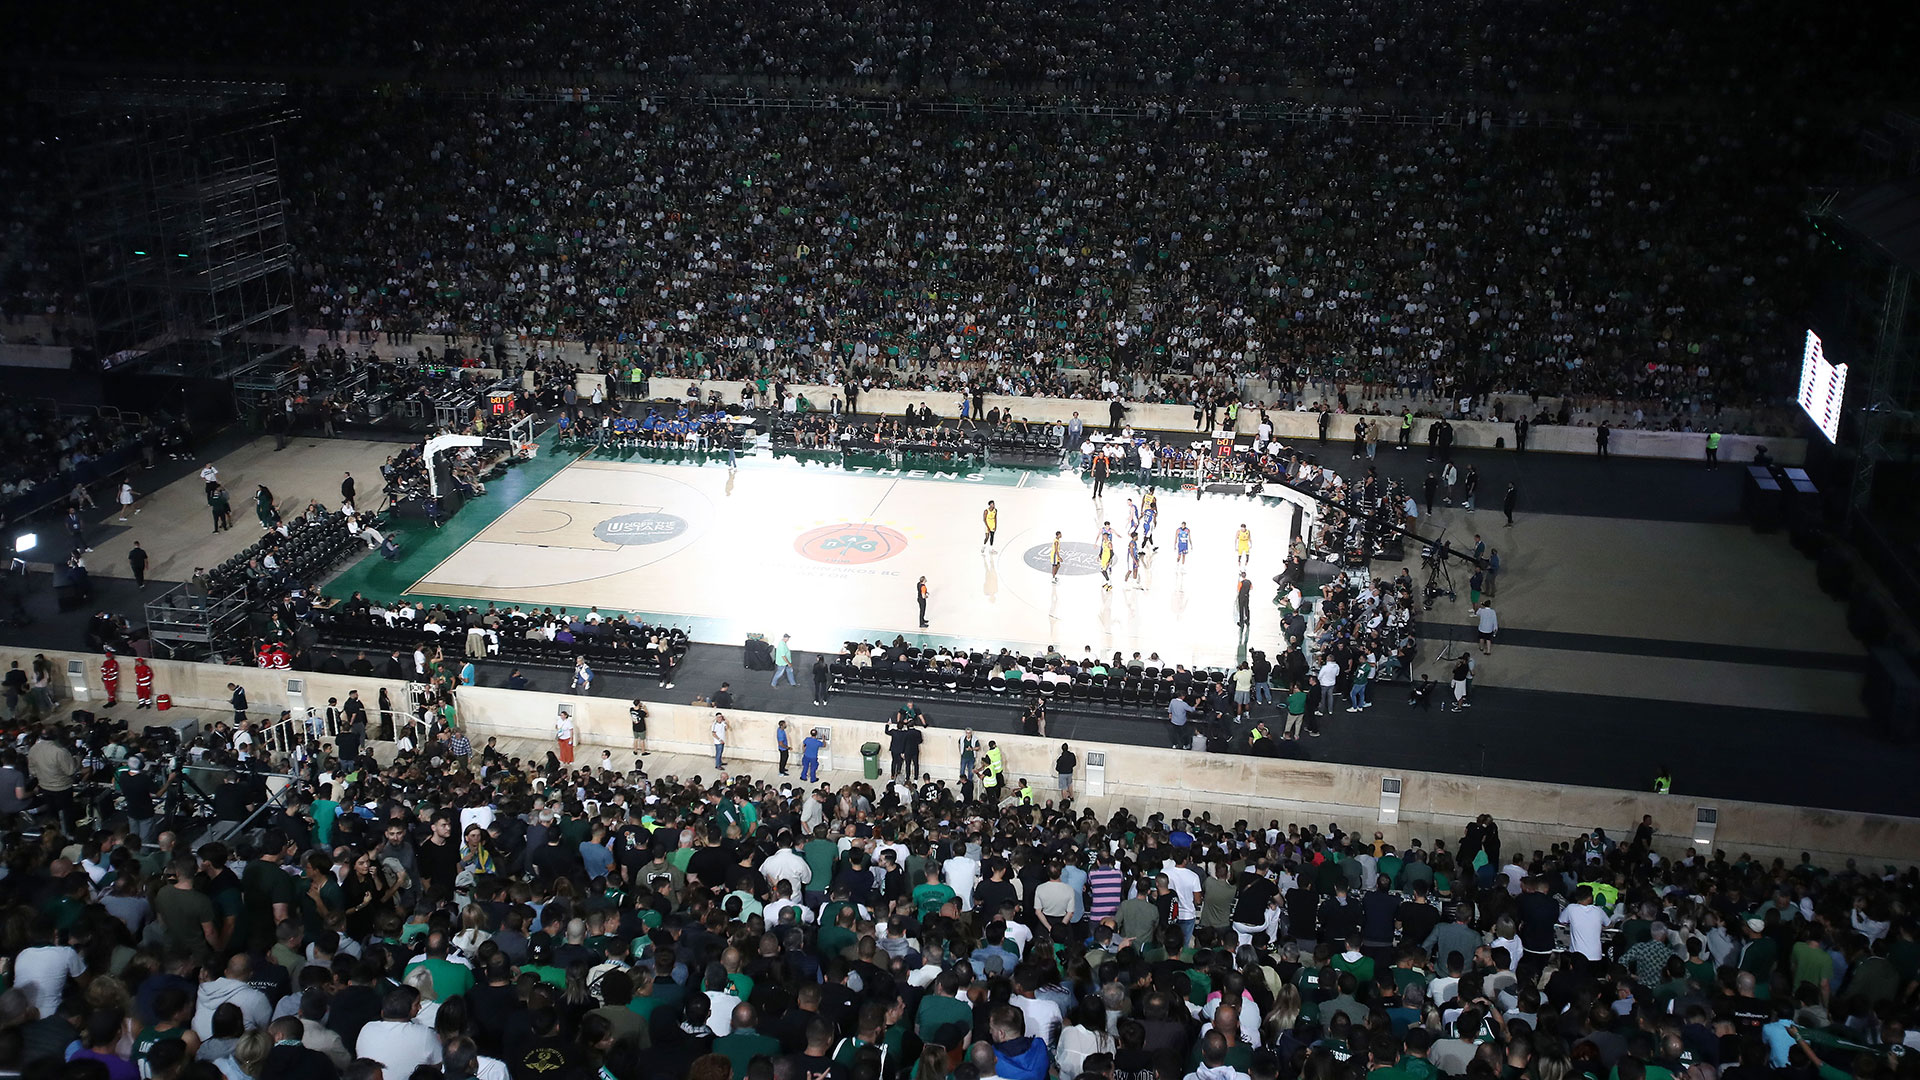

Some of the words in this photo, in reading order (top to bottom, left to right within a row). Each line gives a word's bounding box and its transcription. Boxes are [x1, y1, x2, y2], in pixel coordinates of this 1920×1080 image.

[493, 403, 504, 413] 19
[1218, 446, 1231, 456] 19
[832, 465, 986, 482] THENS
[926, 790, 937, 800] 33
